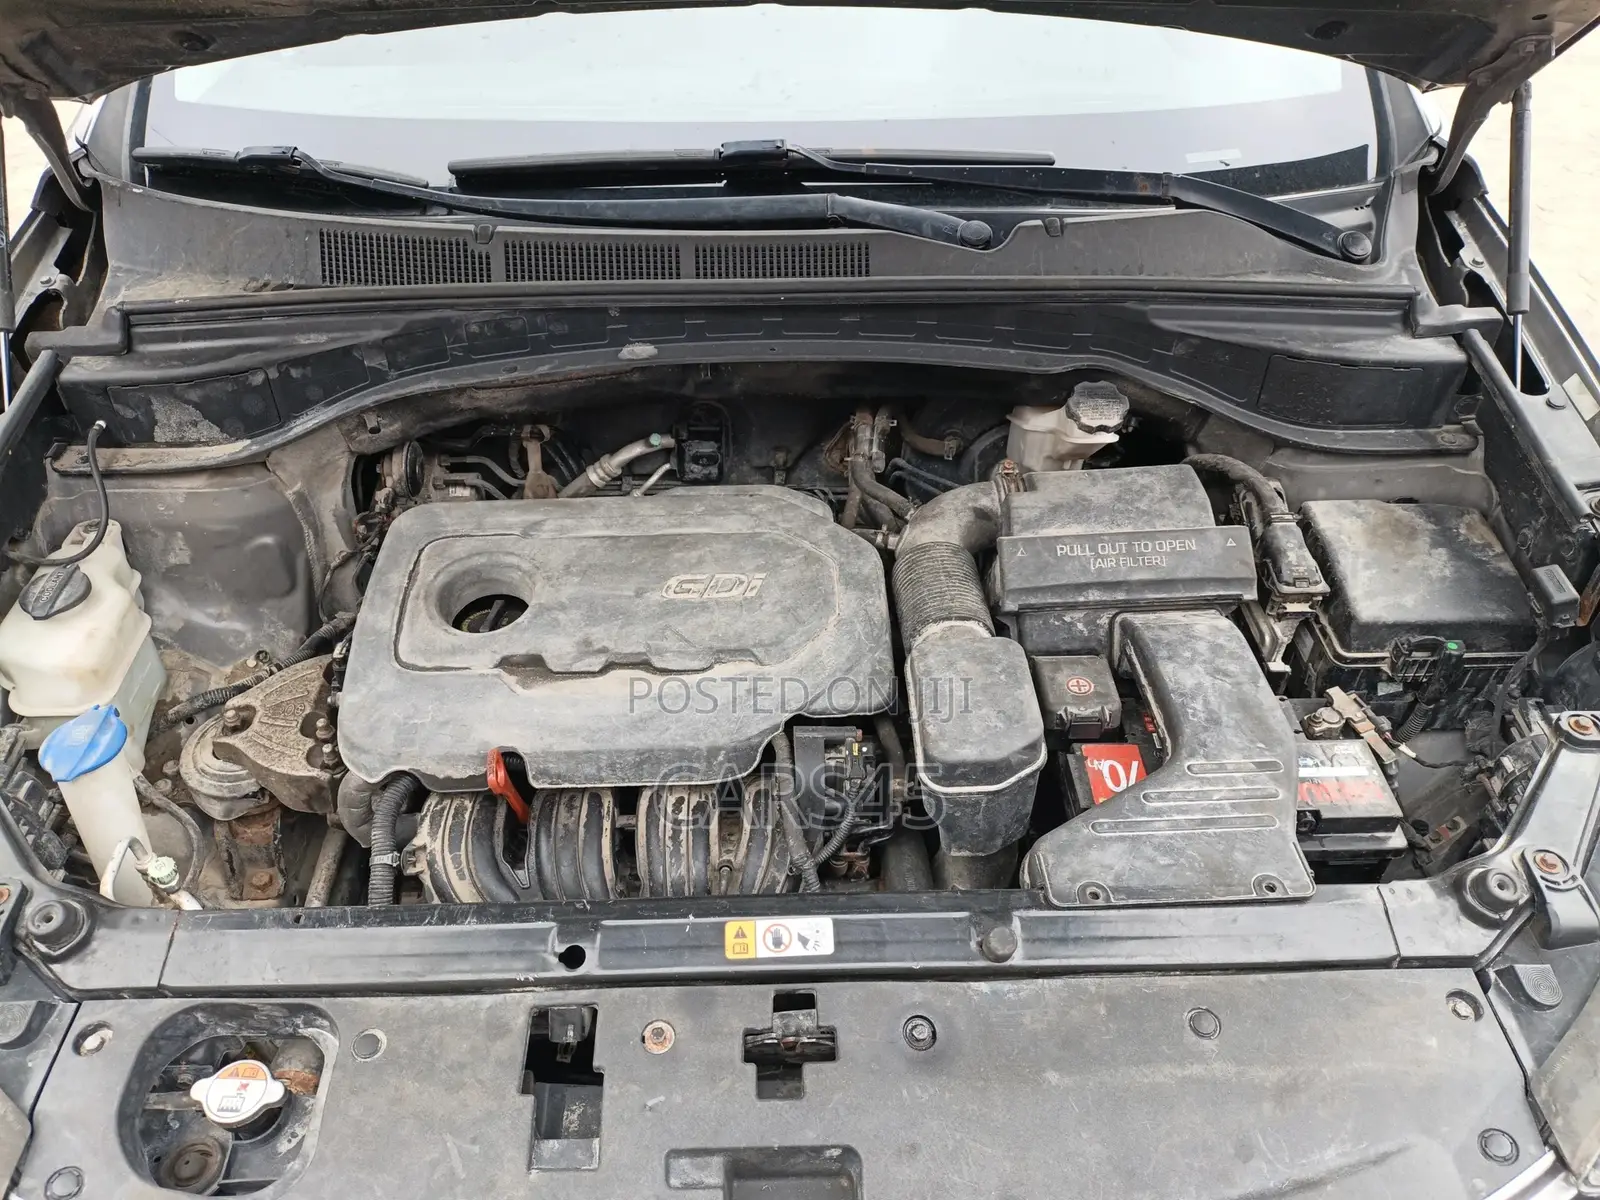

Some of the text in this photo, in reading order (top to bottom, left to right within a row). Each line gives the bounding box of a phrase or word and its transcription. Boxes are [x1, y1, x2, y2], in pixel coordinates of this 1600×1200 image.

[1056, 539, 1197, 557] PULL OUT TO OPEN
